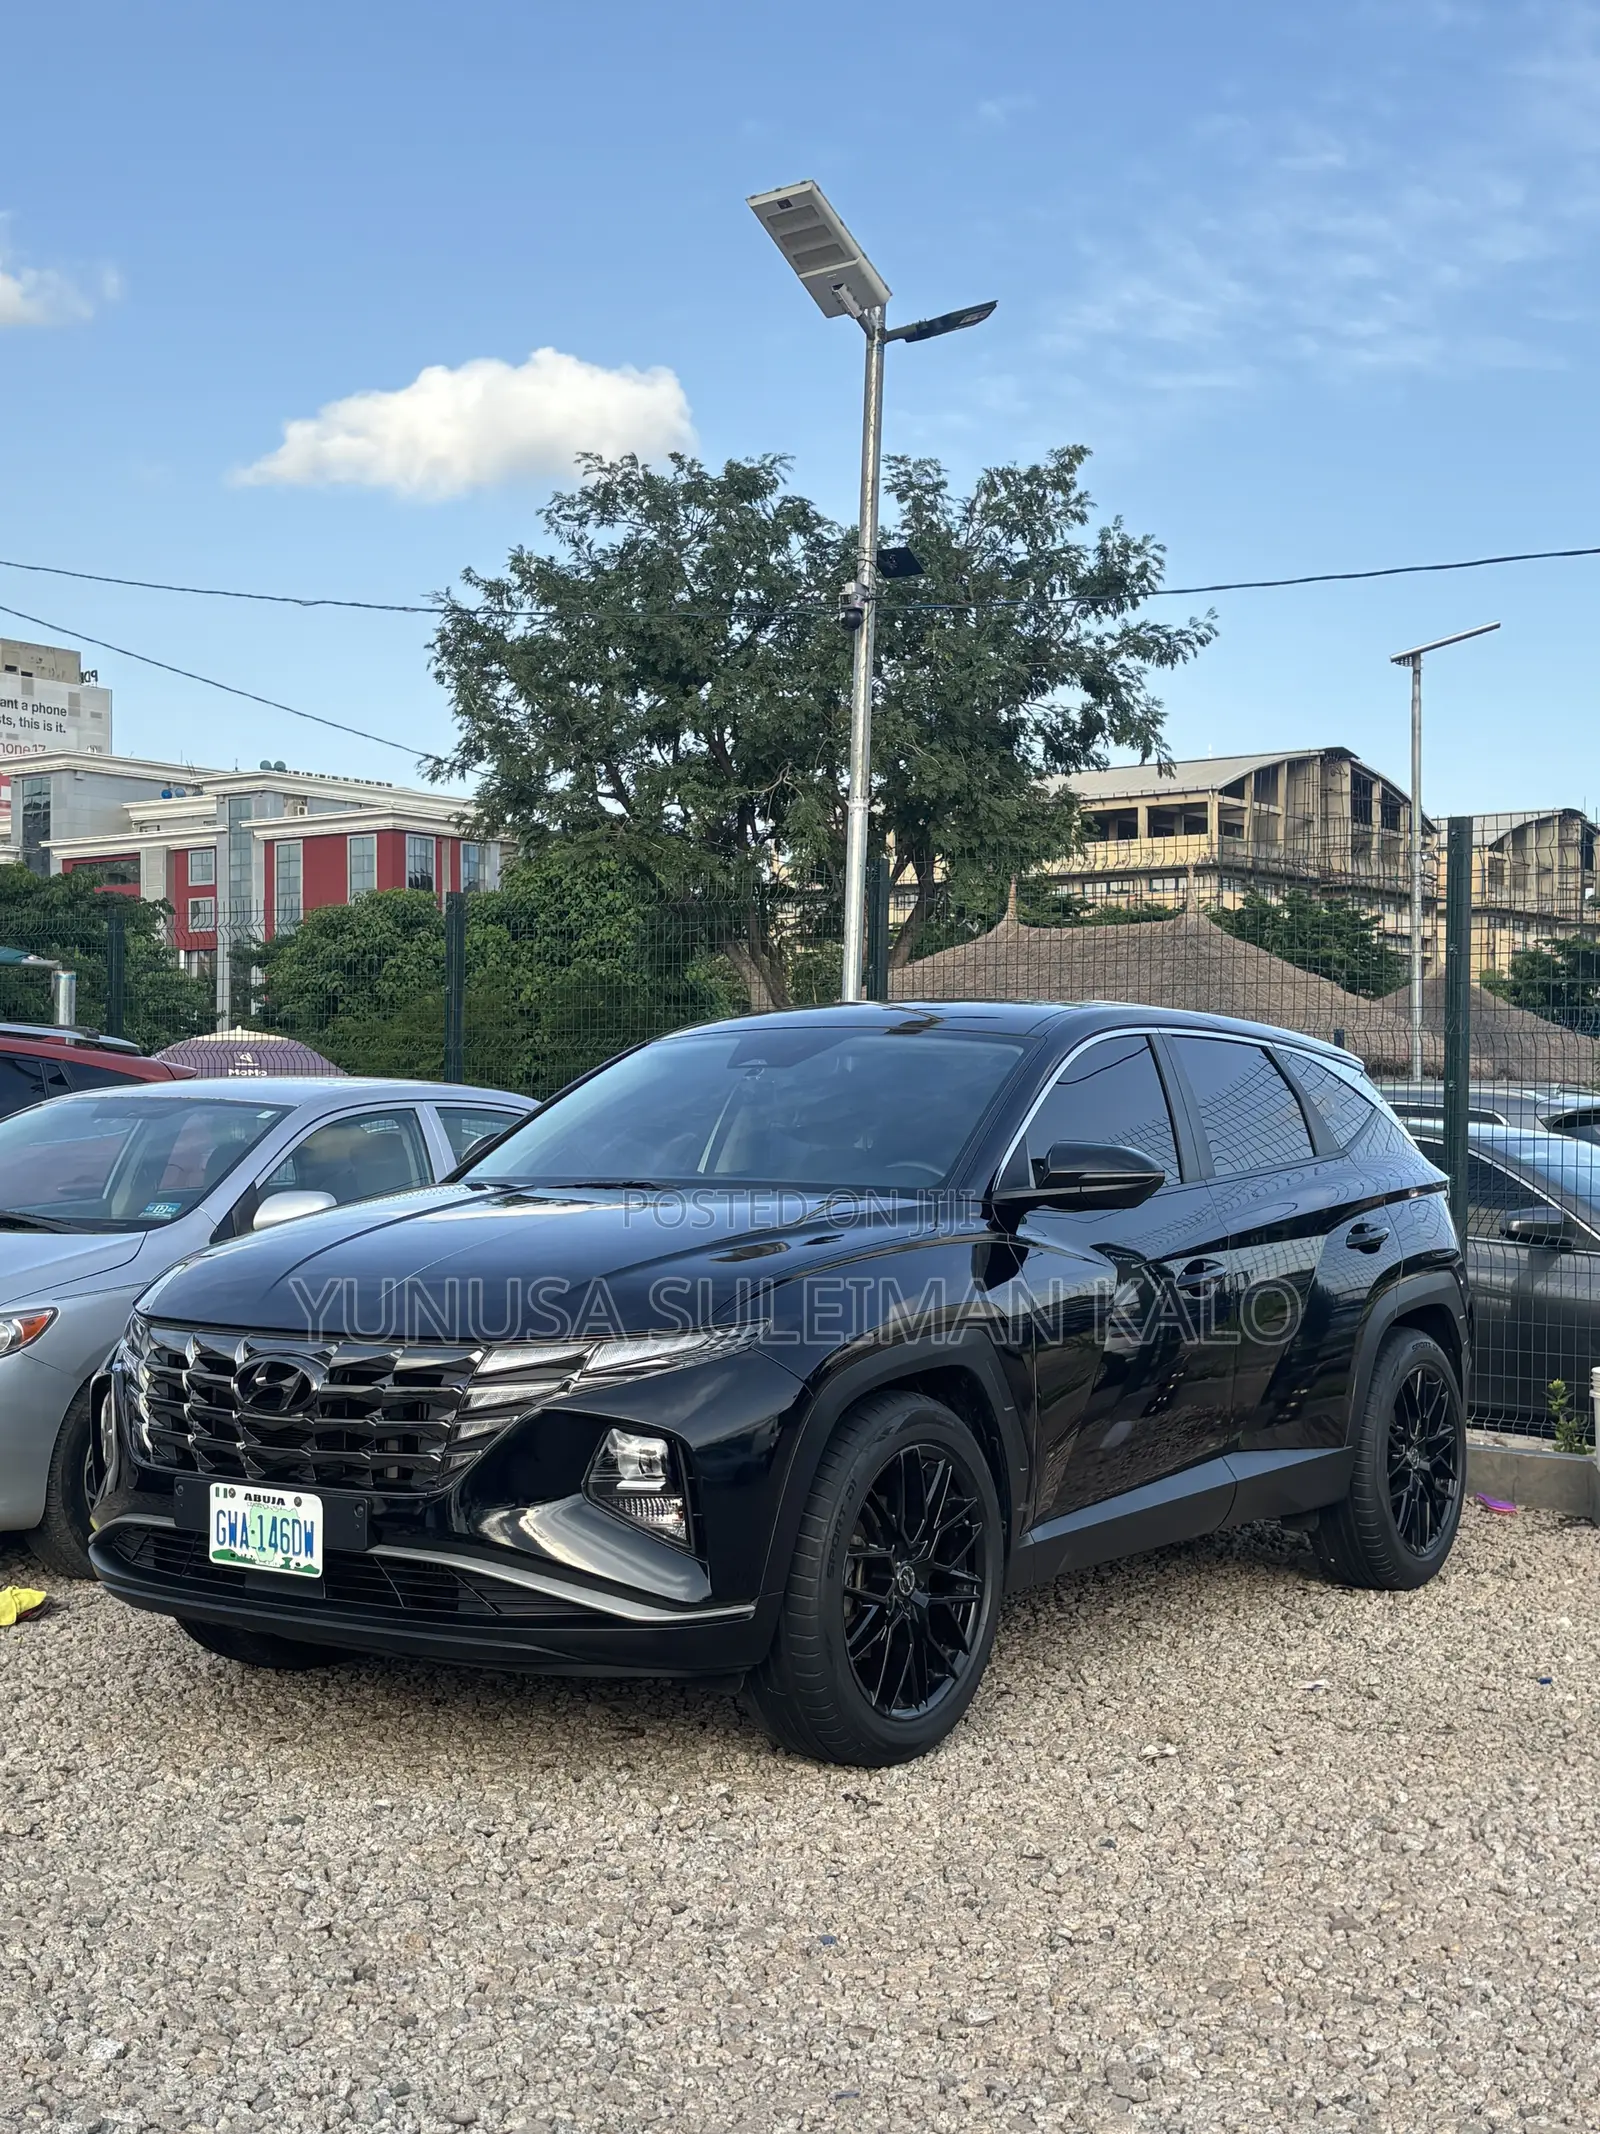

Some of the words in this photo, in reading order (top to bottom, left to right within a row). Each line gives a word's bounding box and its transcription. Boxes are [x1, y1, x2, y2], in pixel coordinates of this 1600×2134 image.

[21, 702, 28, 711] a
[31, 702, 67, 717] phone
[0, 714, 16, 728] ts,
[19, 717, 40, 730] this
[43, 720, 53, 732] is
[55, 721, 66, 734] it.
[228, 1069, 267, 1077] MoMo
[244, 1493, 285, 1506] ABUJA
[826, 1504, 847, 1579] SPORT
